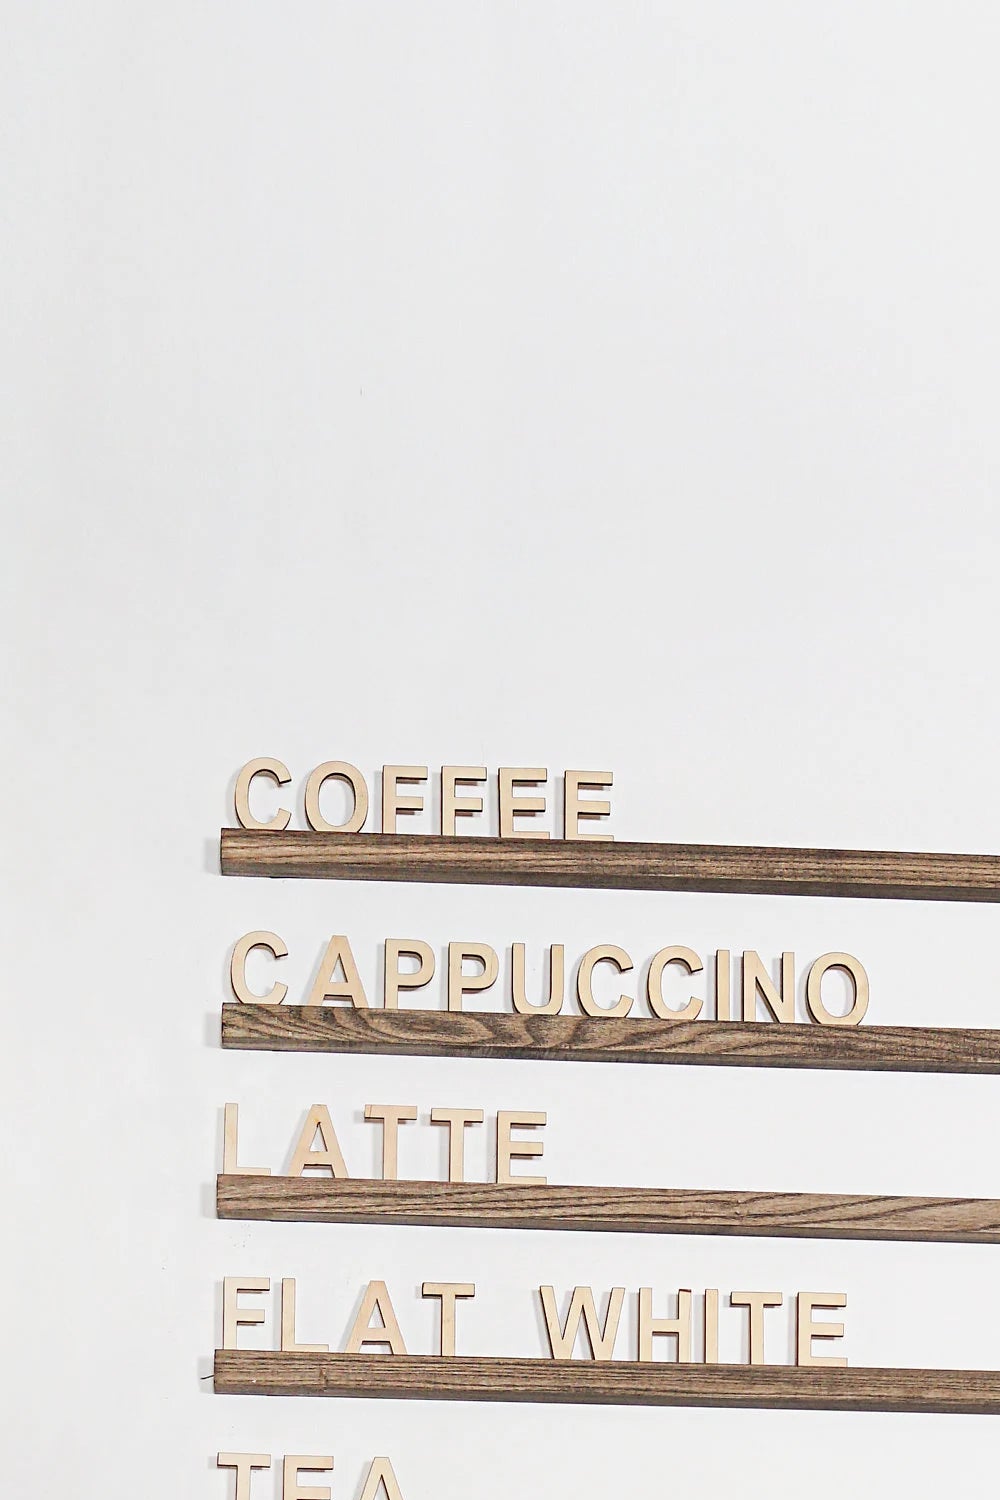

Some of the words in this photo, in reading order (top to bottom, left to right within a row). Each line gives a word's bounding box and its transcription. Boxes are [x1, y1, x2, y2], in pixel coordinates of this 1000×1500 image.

[234, 757, 615, 841] COFFEE
[231, 931, 870, 1026] CAPPUCCINO
[223, 1103, 547, 1184] LATTE
[223, 1276, 475, 1356] FLAT
[539, 1286, 848, 1367] WHITE
